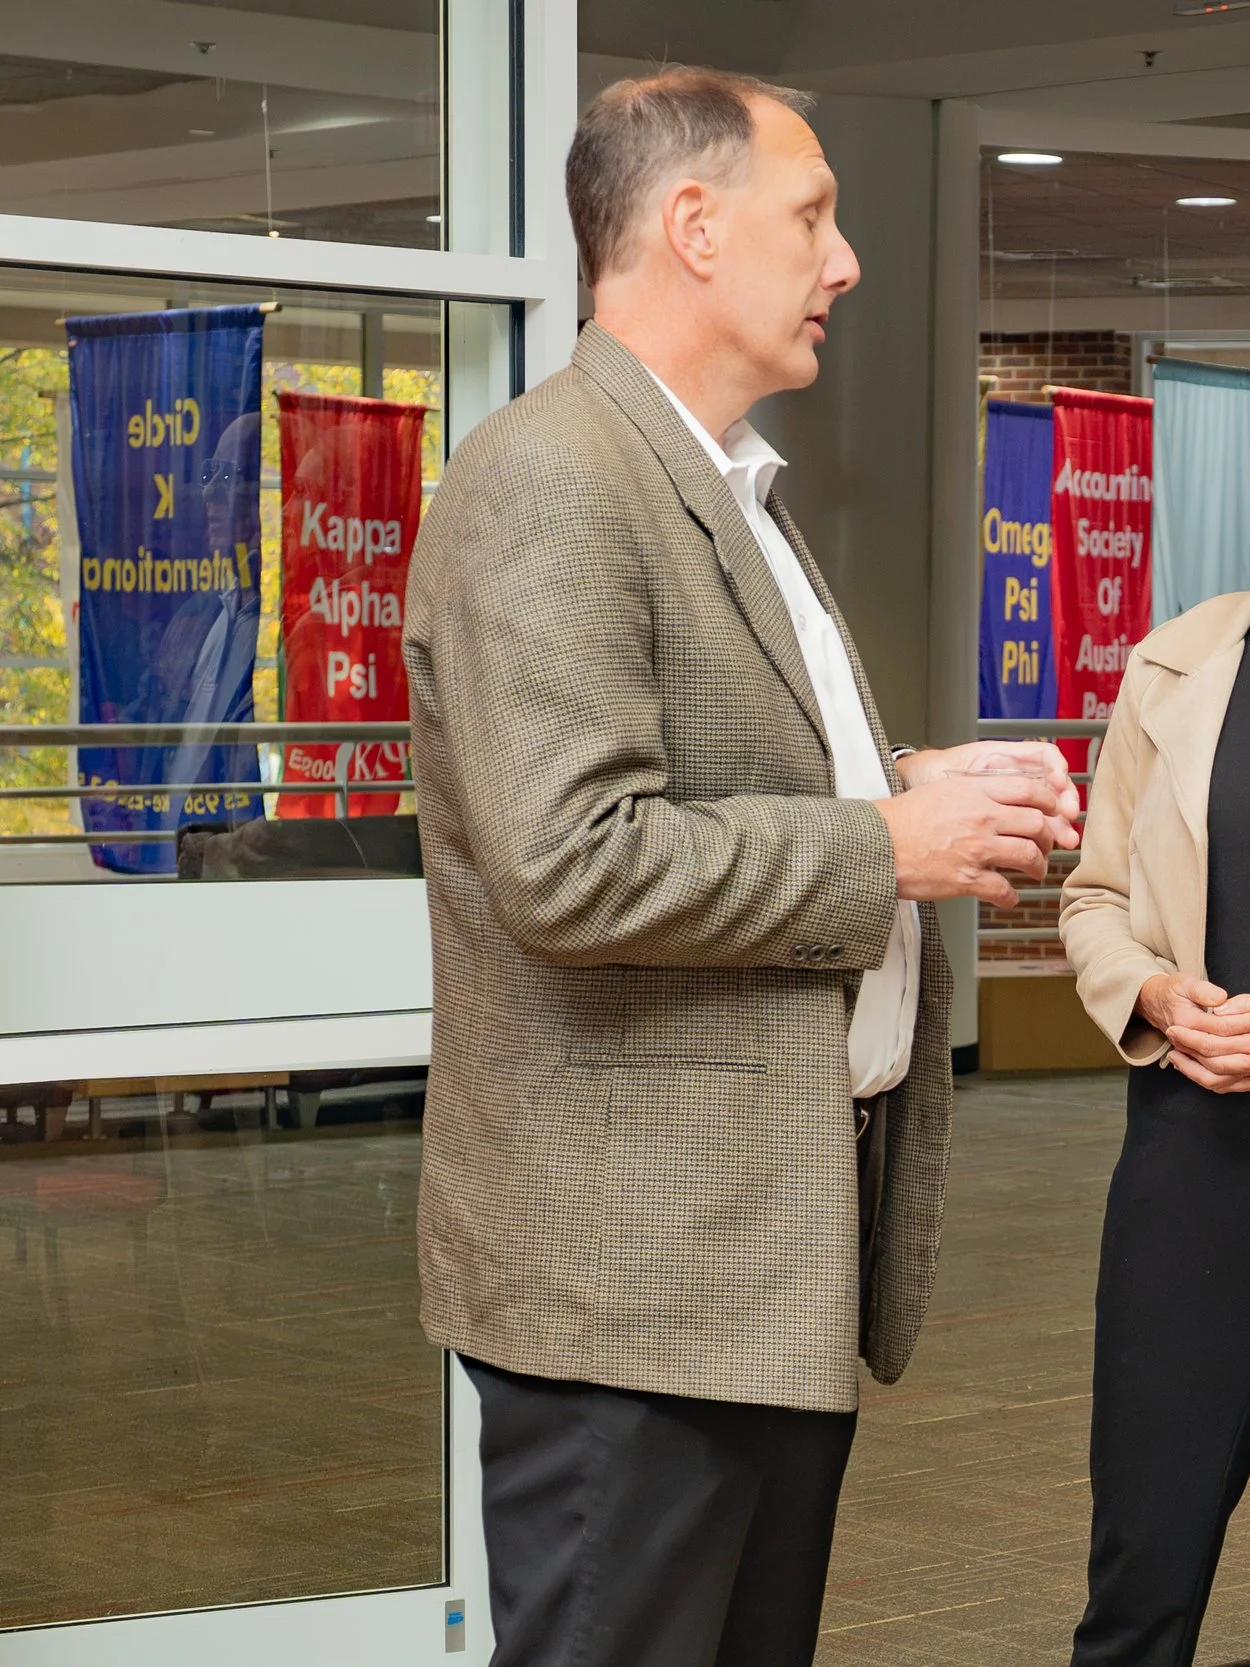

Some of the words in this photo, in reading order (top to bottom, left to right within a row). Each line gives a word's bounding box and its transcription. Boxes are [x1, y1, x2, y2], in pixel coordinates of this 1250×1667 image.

[1054, 457, 1153, 502] Accountin
[300, 500, 401, 565] Kappa
[1077, 517, 1144, 569] Society
[309, 576, 402, 637] Alpha
[1005, 576, 1039, 622] Psi
[1097, 576, 1123, 616] Of
[326, 651, 378, 700] Psi
[1002, 640, 1040, 685] Phi
